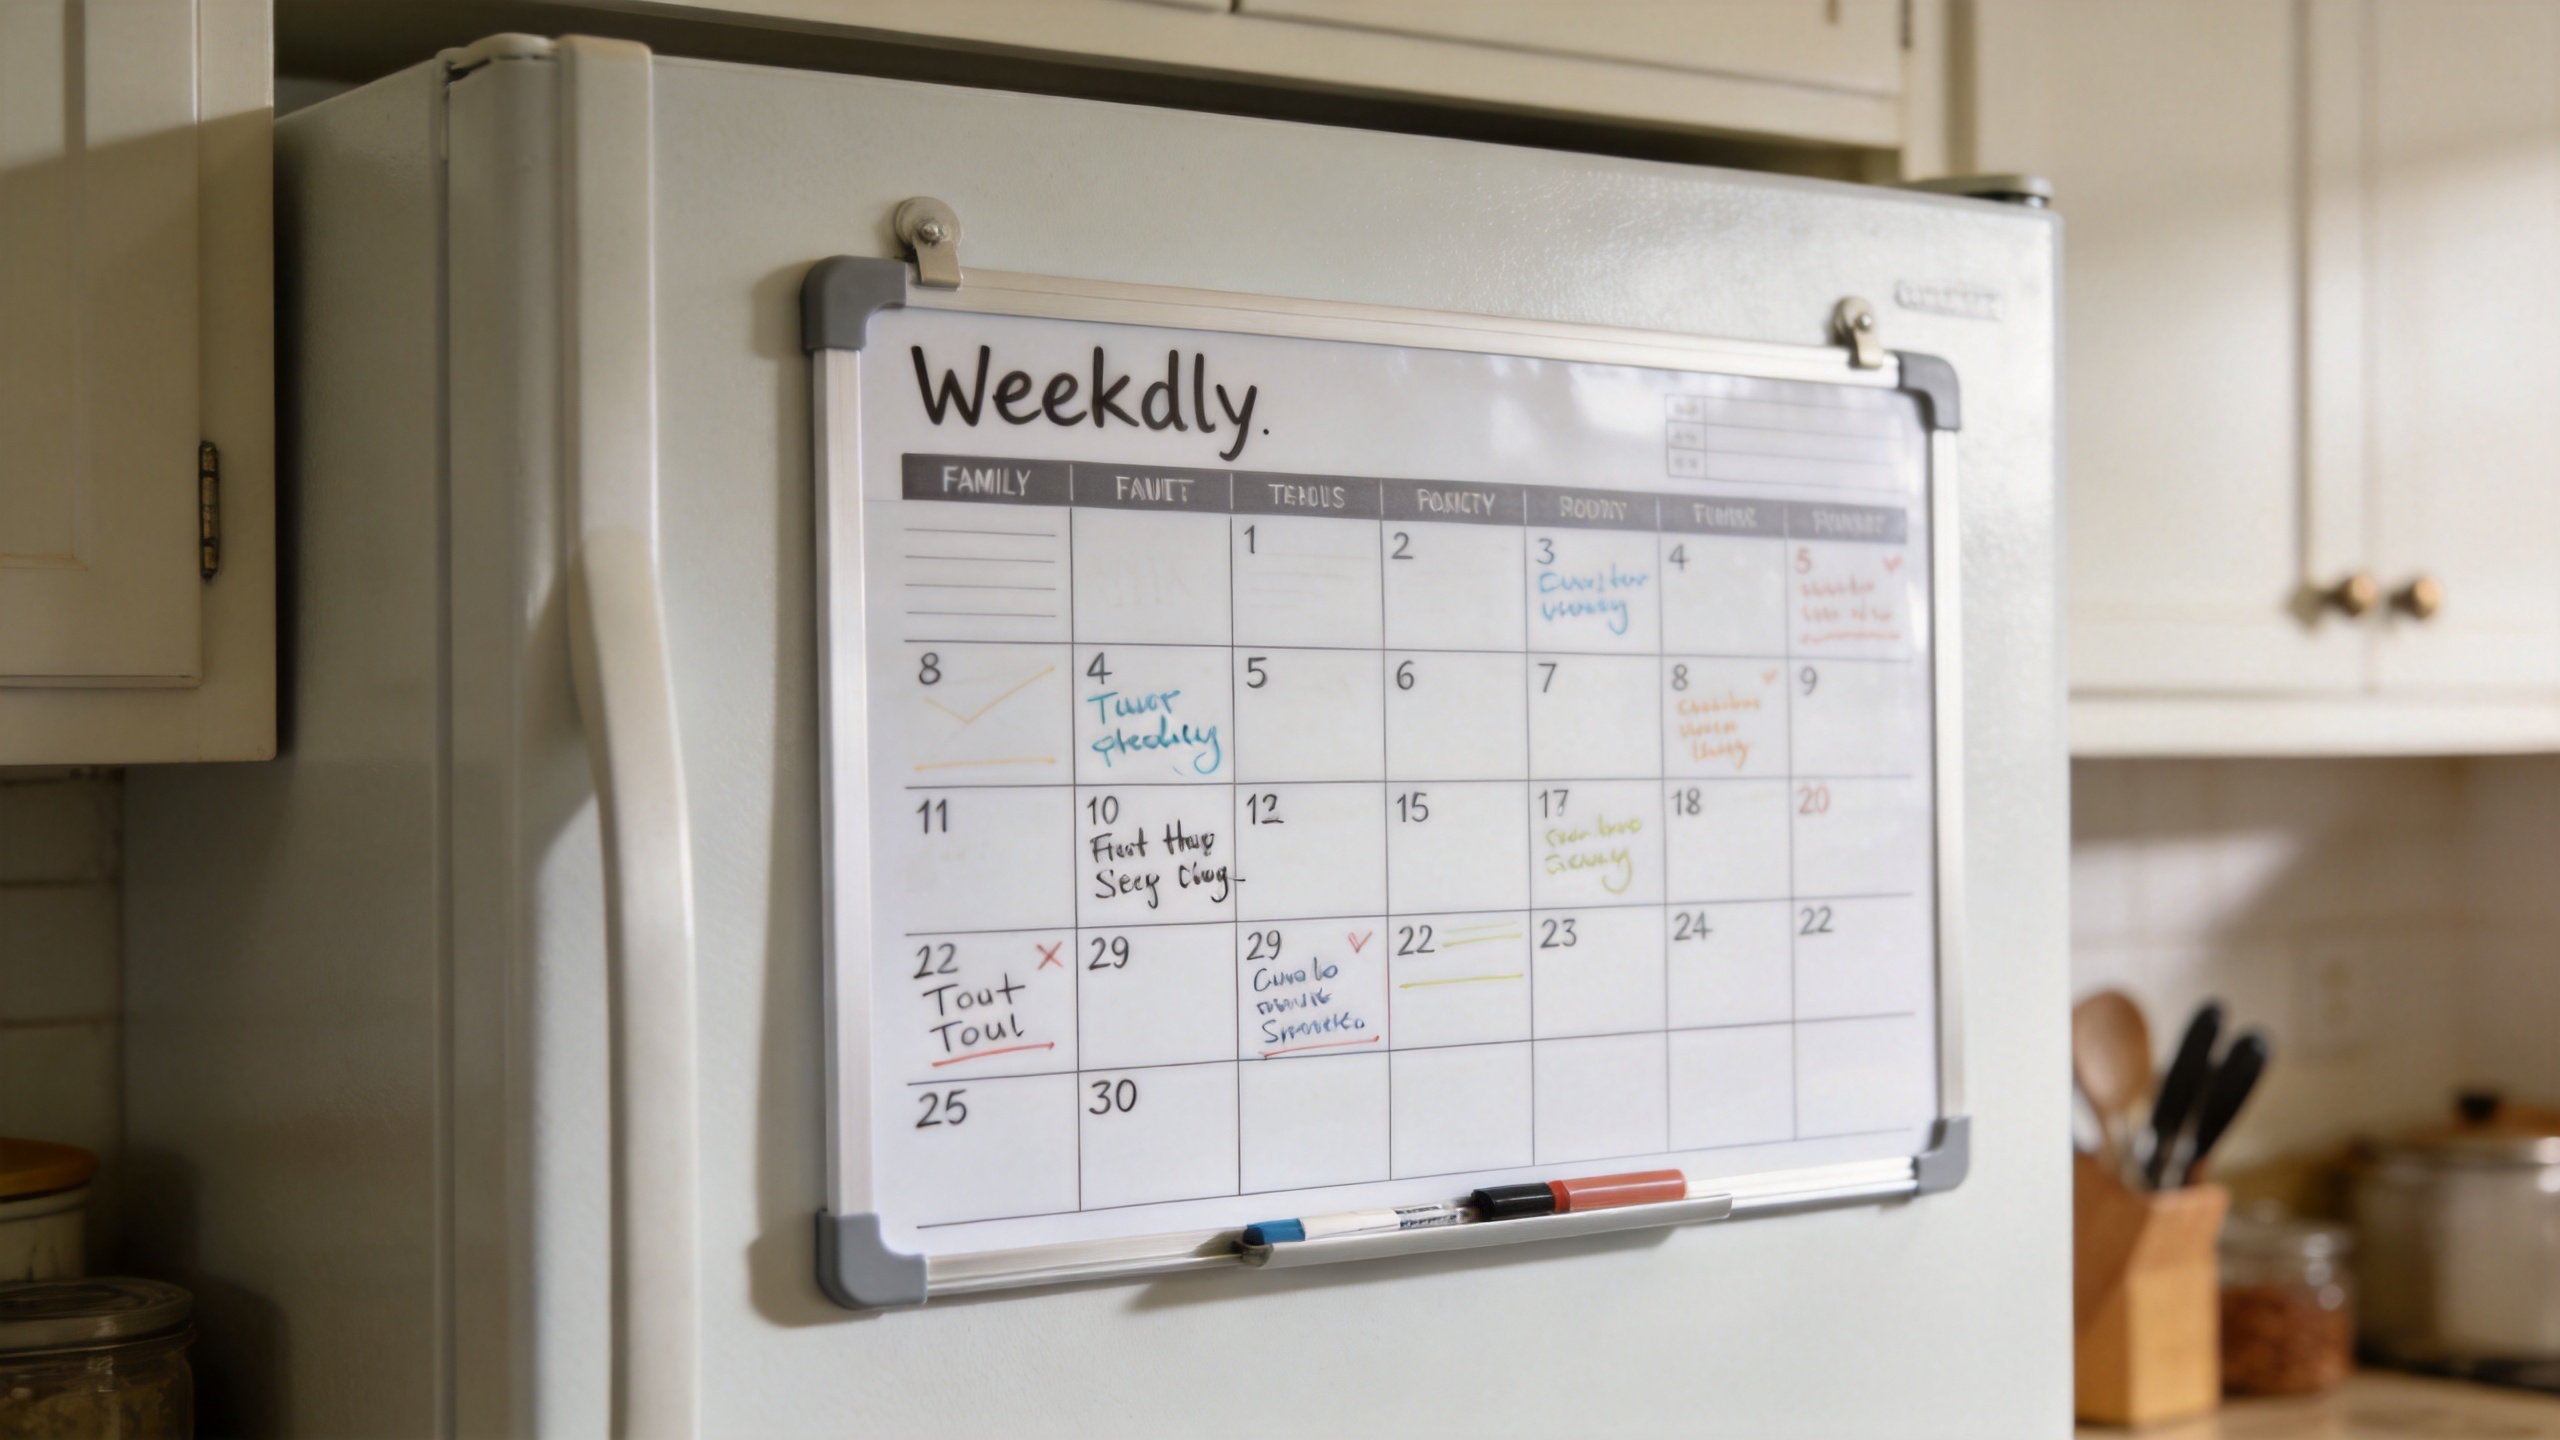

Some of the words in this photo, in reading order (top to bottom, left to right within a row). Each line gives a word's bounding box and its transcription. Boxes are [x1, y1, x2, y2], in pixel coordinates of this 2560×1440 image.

[942, 465, 1031, 497] FAMILY
[1243, 524, 1256, 555] 1
[1391, 531, 1414, 561] 2
[1536, 537, 1556, 566] 3
[1668, 543, 1690, 571] 4
[917, 651, 942, 687] 8
[1086, 651, 1113, 685] 4
[1246, 656, 1268, 690] 5
[1395, 659, 1415, 691] 6
[1537, 662, 1558, 694] 7
[1671, 663, 1689, 692] 8
[1801, 666, 1818, 696] 9
[1087, 794, 1120, 826] 10
[1246, 793, 1285, 825] 12
[1396, 791, 1430, 823] 15
[1538, 788, 1569, 818] 17
[1671, 787, 1702, 816] 18
[1799, 785, 1831, 815] 20
[916, 798, 948, 835] 11
[1539, 917, 1577, 950] 23
[1673, 911, 1712, 942] 24
[1799, 905, 1834, 935] 22
[1087, 935, 1130, 972] 29
[1246, 929, 1283, 962] 29
[1396, 924, 1436, 957] 22
[912, 942, 959, 980] 22
[922, 972, 1027, 1017] Tout
[915, 1089, 968, 1130] 25
[1088, 1078, 1138, 1115] 30
